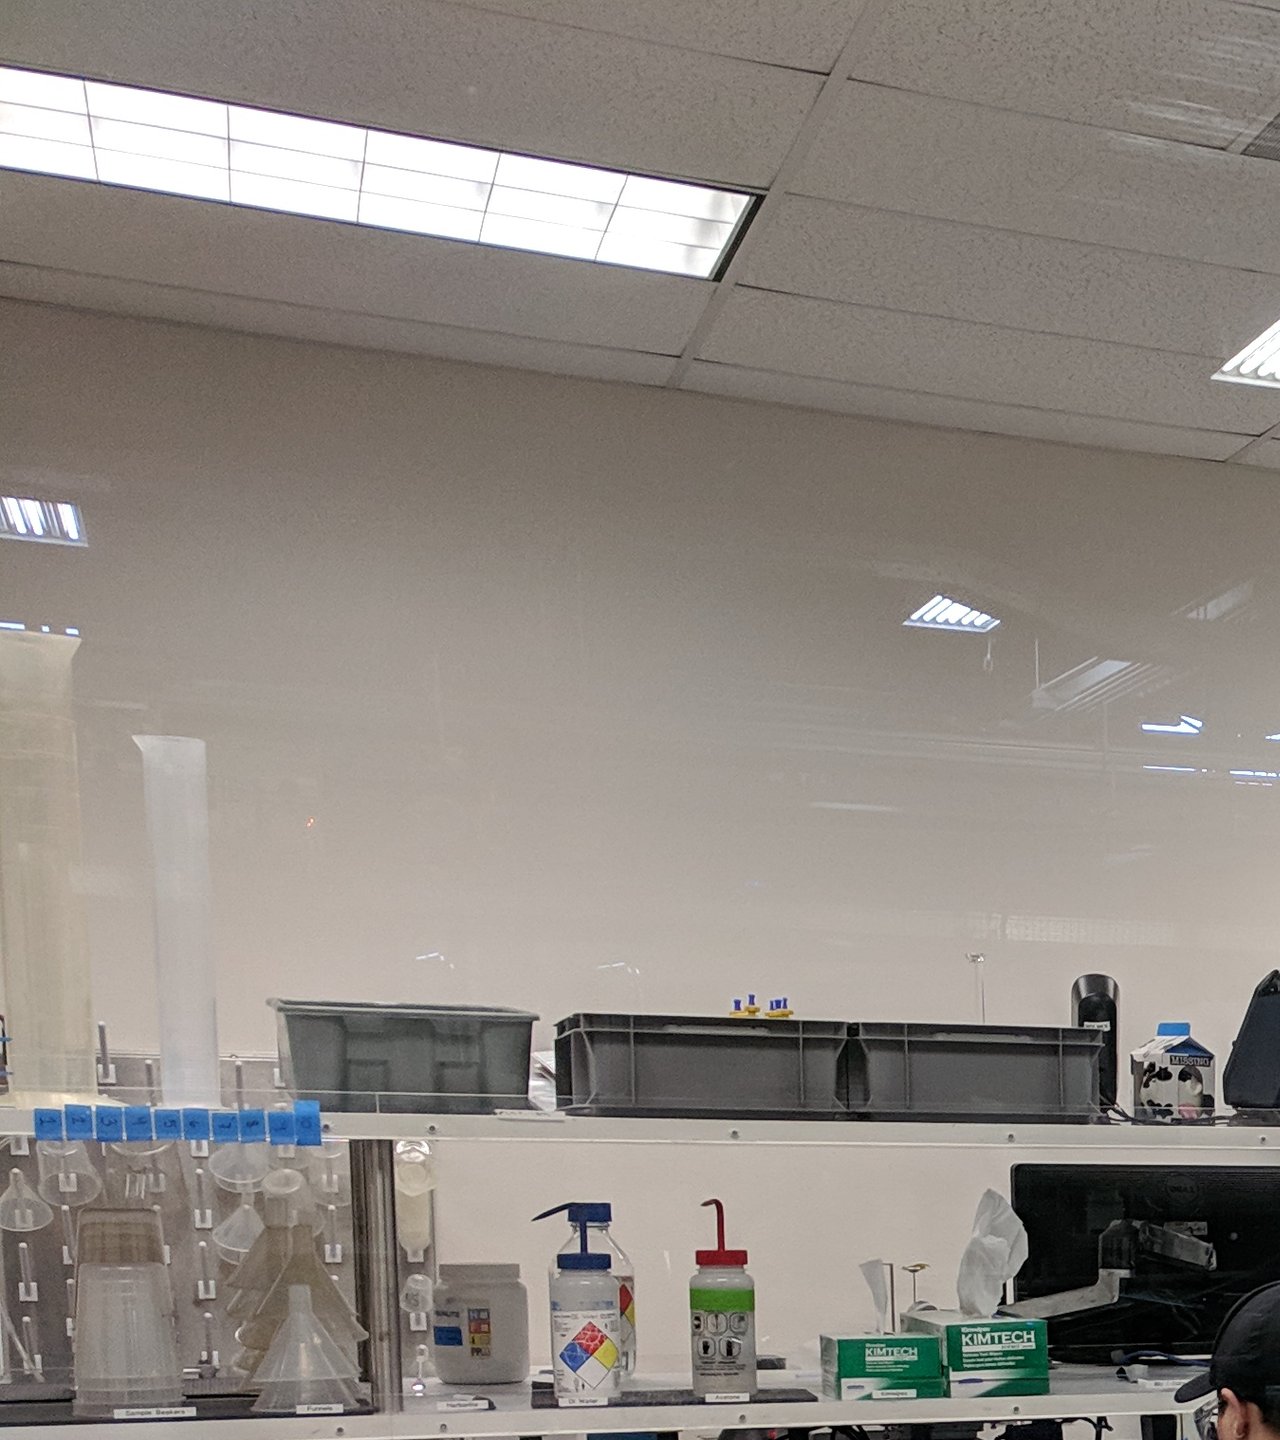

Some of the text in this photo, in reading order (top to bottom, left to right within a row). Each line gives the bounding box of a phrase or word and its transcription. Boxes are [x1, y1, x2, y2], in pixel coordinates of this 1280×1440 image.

[1171, 1055, 1210, 1066] MISSING
[961, 1330, 1036, 1346] KIMTECH
[865, 1346, 918, 1357] KIMTECH
